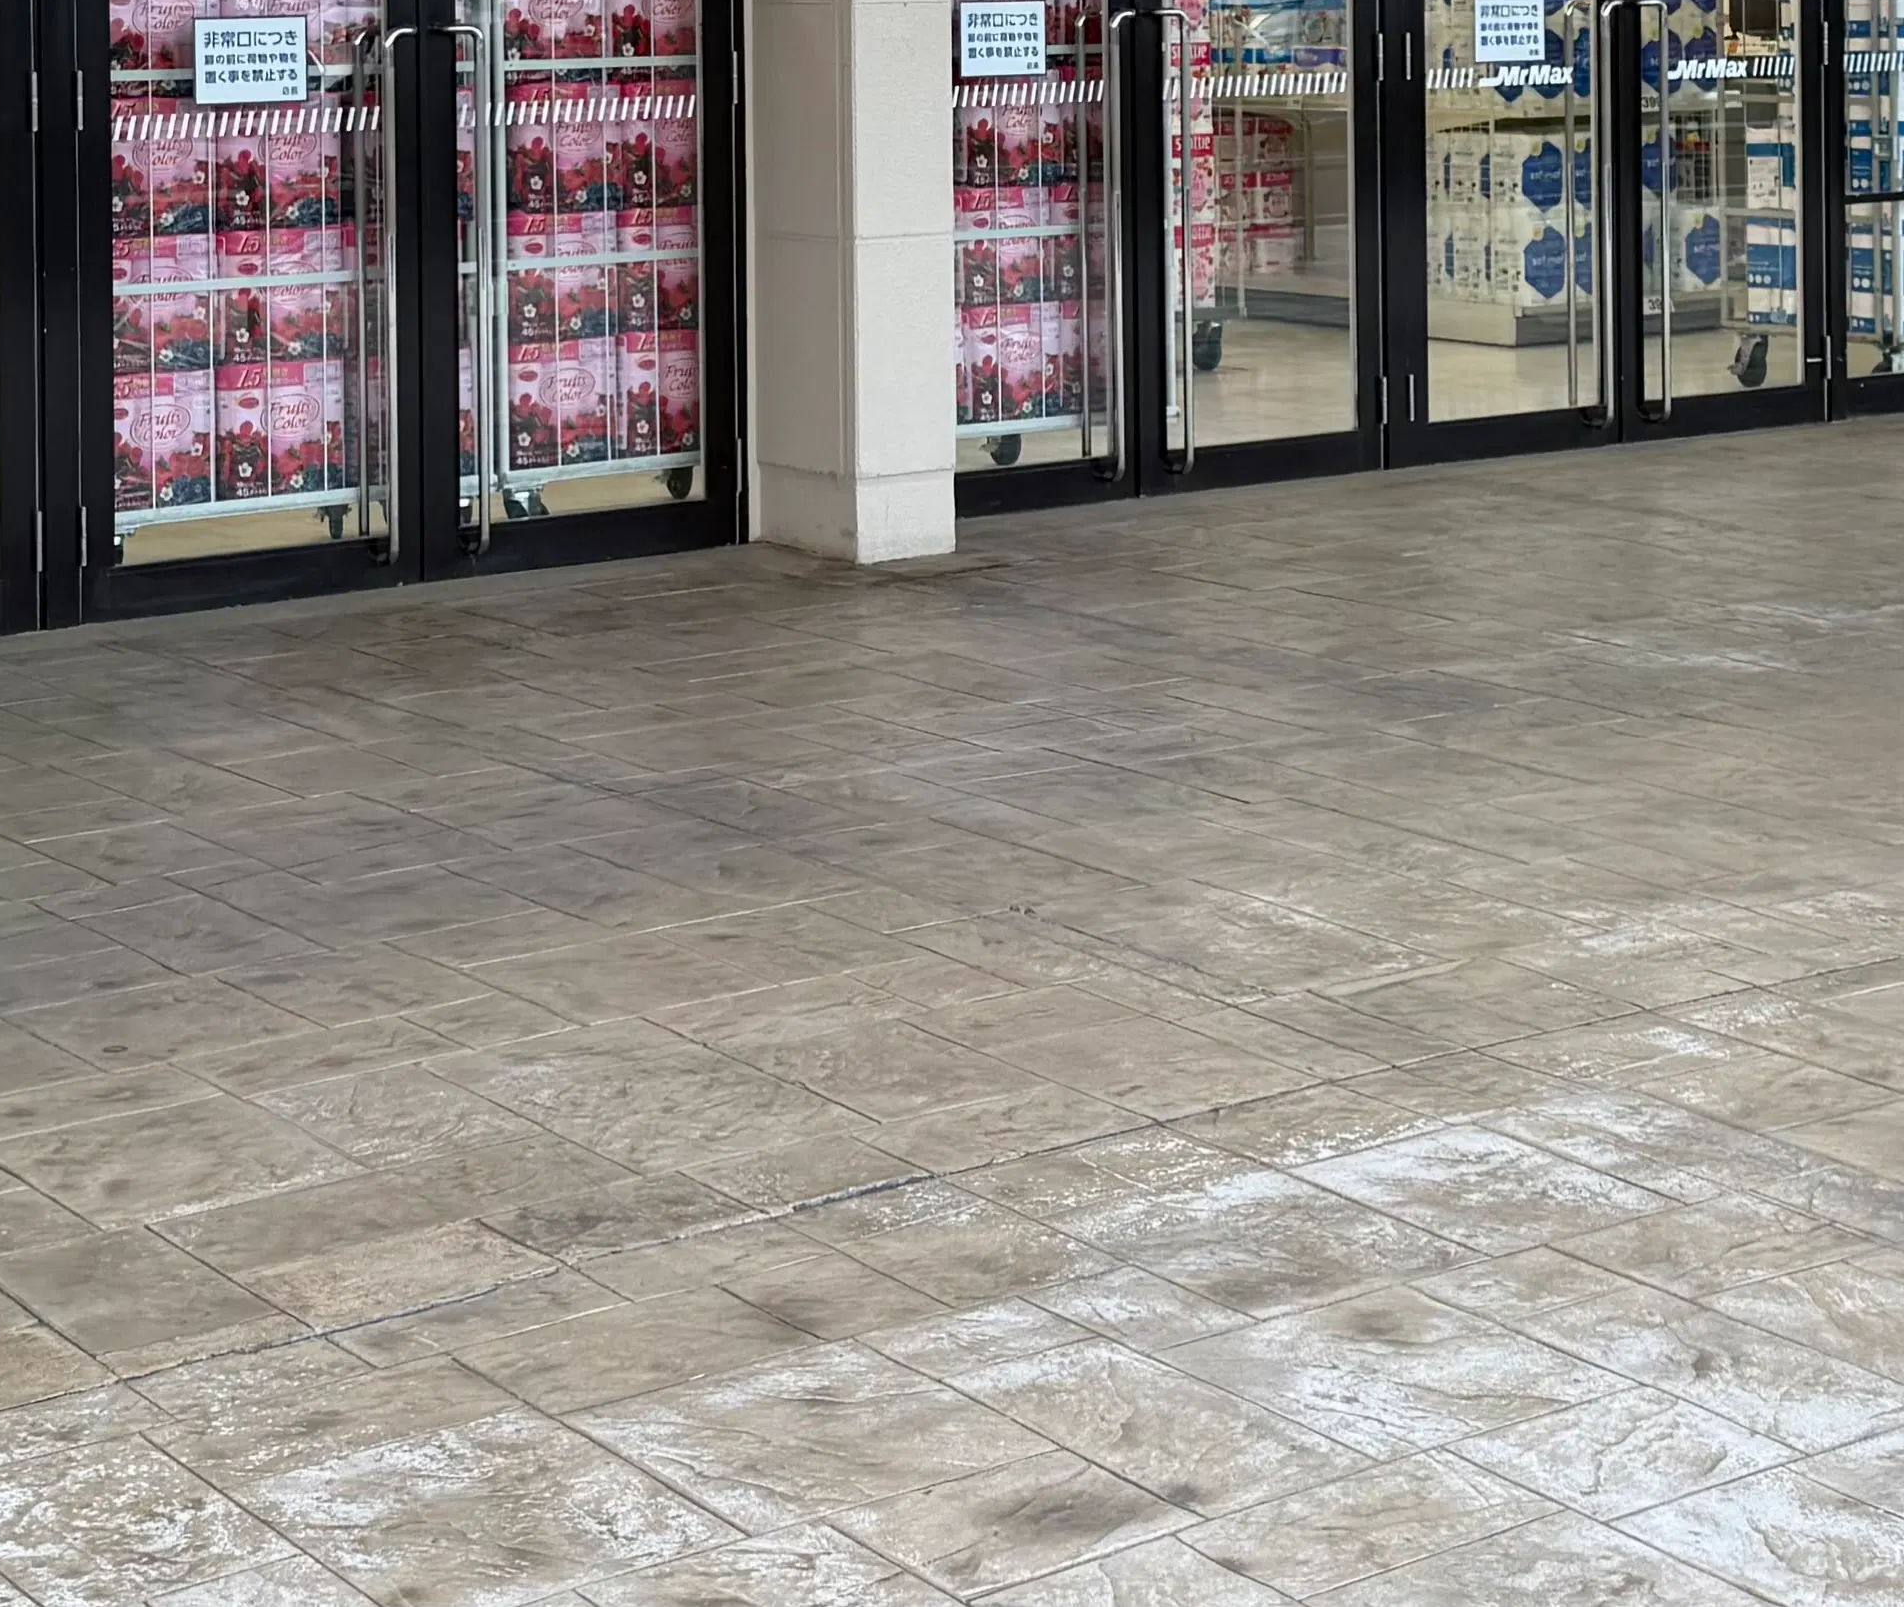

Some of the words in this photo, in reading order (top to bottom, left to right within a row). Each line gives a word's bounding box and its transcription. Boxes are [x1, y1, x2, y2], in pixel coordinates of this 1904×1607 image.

[144, 12, 183, 29] Color
[1477, 64, 1574, 88] MrMax
[1667, 58, 1749, 81] MrMax
[559, 133, 594, 148] Color
[270, 144, 307, 162] Color
[237, 234, 261, 253] 1.5
[236, 368, 263, 388] 1.5
[548, 376, 586, 392] Fruits
[553, 389, 587, 404] Color
[269, 400, 312, 416] Fruits
[137, 411, 182, 428] Fruits
[272, 414, 311, 431] Color
[143, 425, 181, 442] Color
